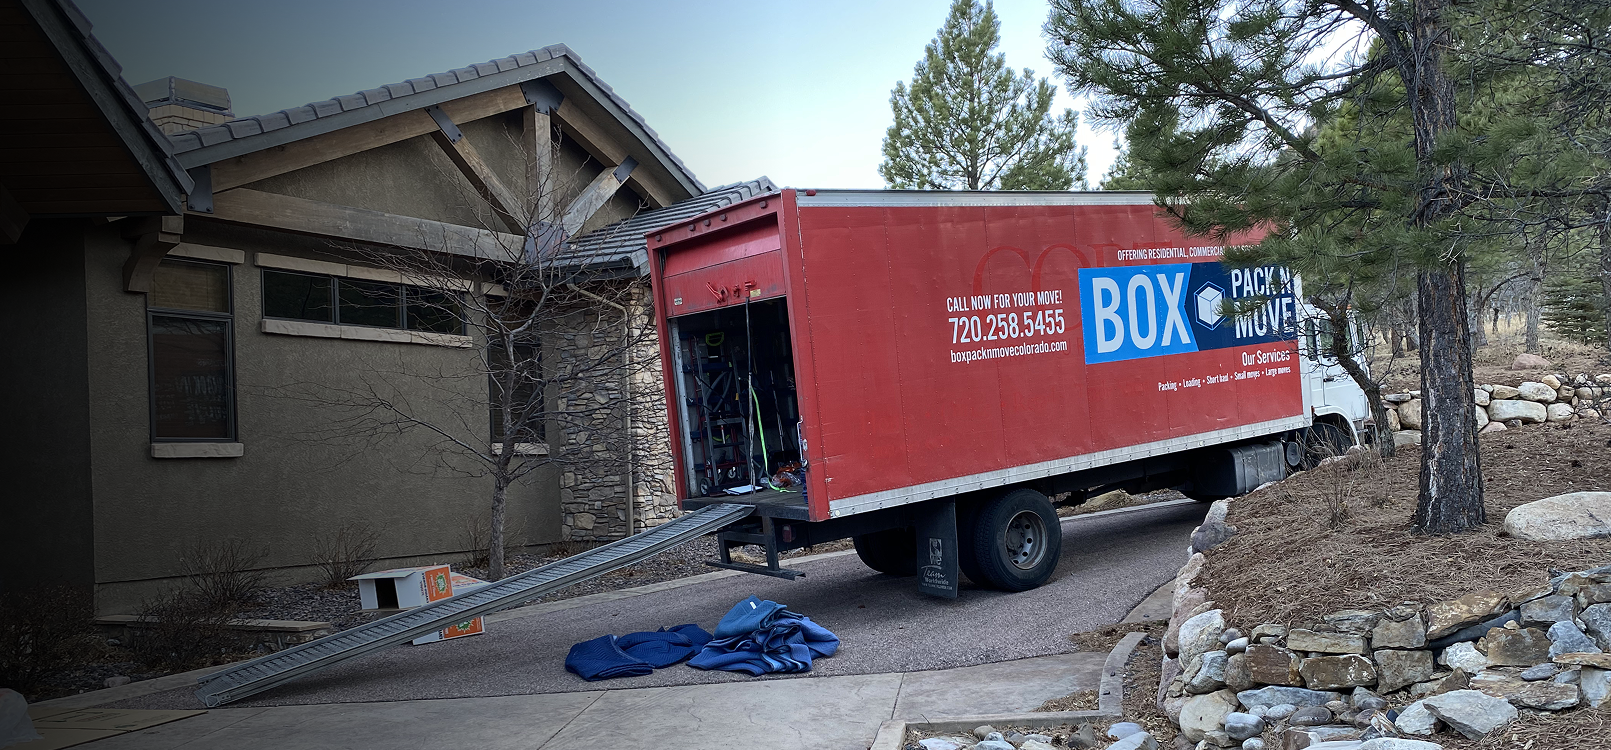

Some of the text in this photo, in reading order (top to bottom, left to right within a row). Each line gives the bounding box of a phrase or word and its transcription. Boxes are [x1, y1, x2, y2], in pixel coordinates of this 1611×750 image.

[1117, 249, 1147, 261] OFFERING
[1148, 247, 1189, 260] RESIDENTIAL,
[1231, 266, 1291, 298] PACK N
[946, 289, 1063, 312] CALL NOW FOR YOUR MOVE!
[1092, 272, 1192, 354] BOX
[948, 309, 1065, 344] 720.258.5455
[1234, 297, 1295, 338] MOVE
[950, 340, 1068, 364] boxpacknmovecolorado.com
[1242, 348, 1291, 366] Our Services
[1158, 366, 1291, 392] Packing Loading Short haul Small moves Large moves
